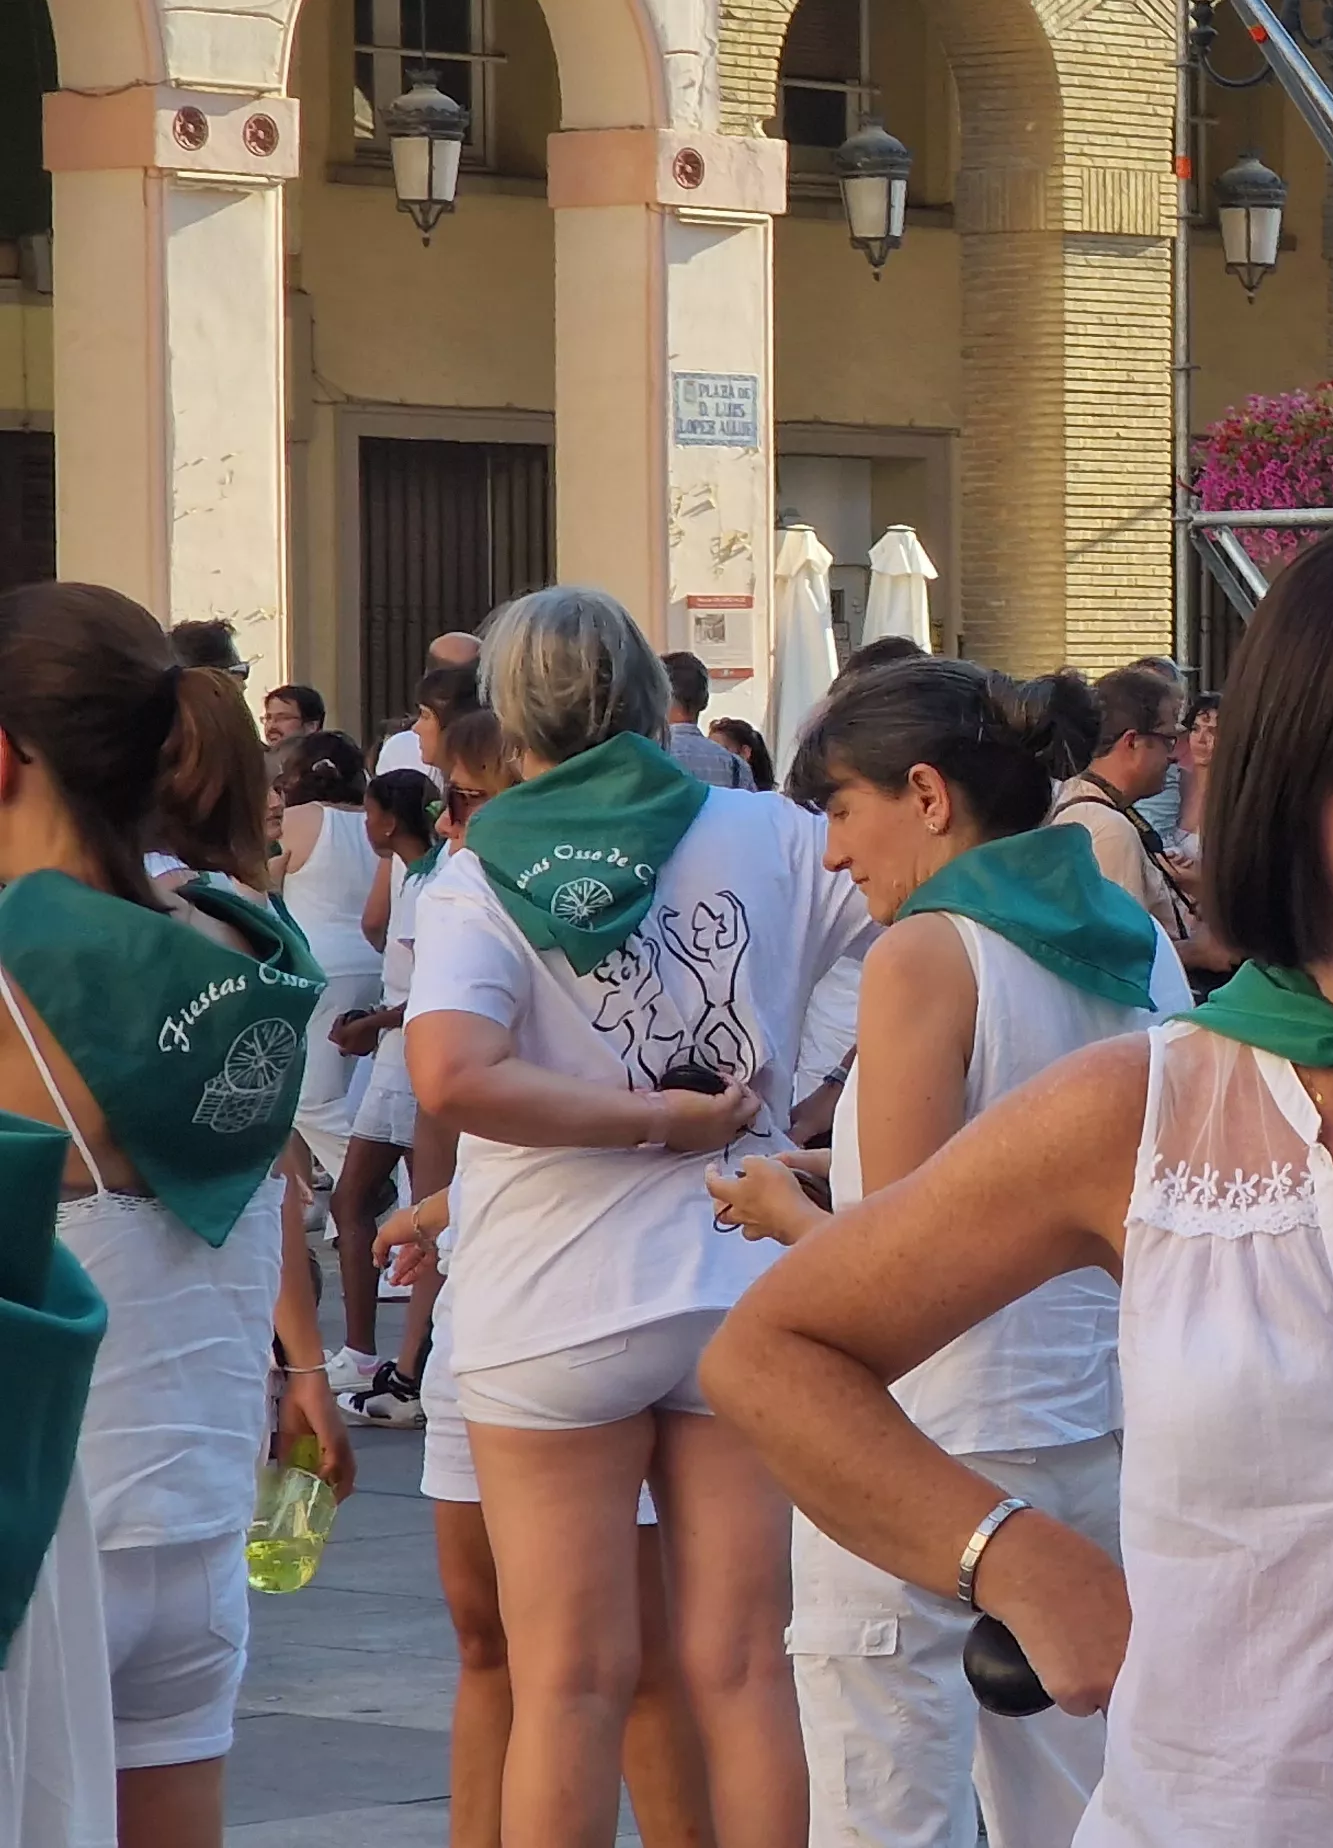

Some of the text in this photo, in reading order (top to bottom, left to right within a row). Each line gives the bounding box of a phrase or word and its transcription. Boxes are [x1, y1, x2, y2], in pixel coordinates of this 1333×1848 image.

[698, 383, 752, 399] PLAZA DE
[715, 402, 745, 418] LUIS
[516, 857, 552, 889] estas
[554, 844, 603, 861] Osso
[606, 848, 630, 868] de
[158, 974, 249, 1053] Fiestas
